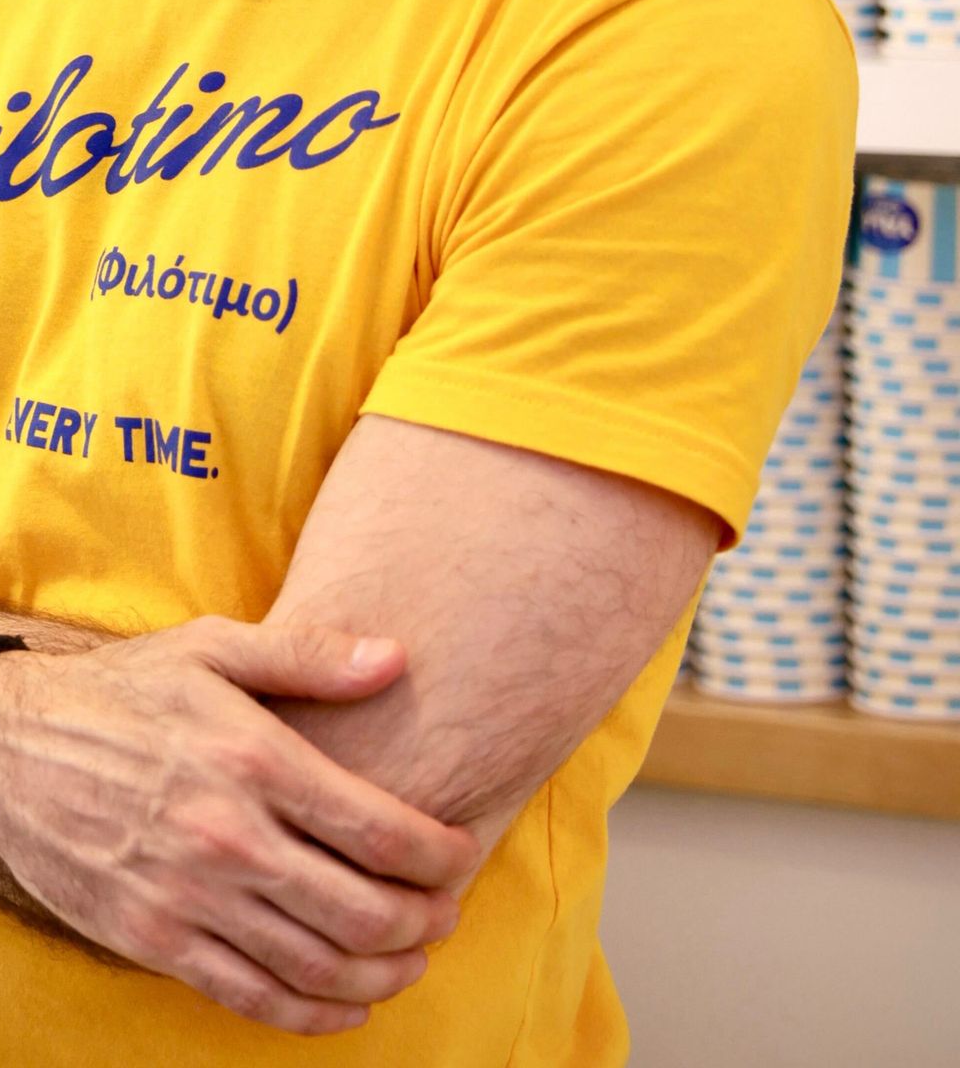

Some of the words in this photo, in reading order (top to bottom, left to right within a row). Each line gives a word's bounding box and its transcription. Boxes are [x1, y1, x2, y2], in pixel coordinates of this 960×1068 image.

[91, 246, 298, 335] (Φιλότιμο)
[5, 397, 98, 458] VERY
[115, 416, 219, 479] TIME.
